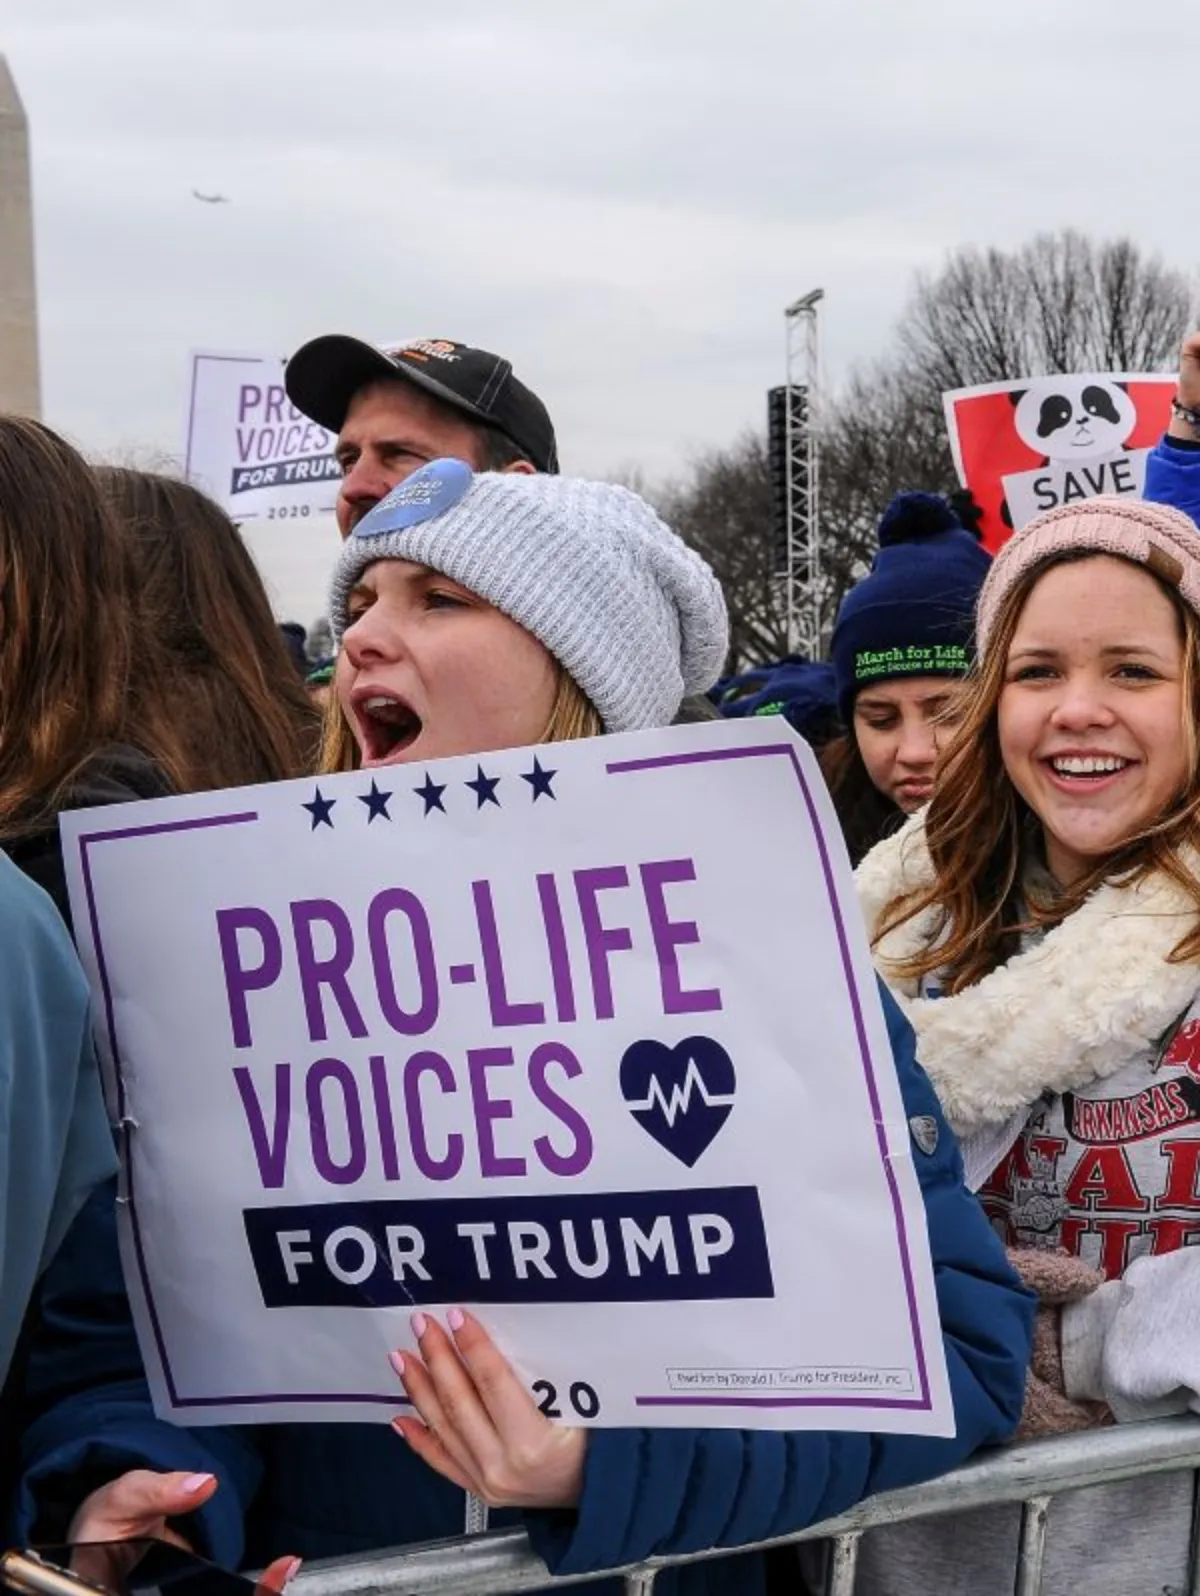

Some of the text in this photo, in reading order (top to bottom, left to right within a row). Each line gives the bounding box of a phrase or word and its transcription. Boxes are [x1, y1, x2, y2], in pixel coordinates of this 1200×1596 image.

[236, 424, 330, 462] VOICES
[237, 458, 341, 489] FOR TRUM
[1033, 458, 1136, 511] SAVE
[267, 505, 310, 520] 2020
[856, 645, 965, 667] March for Life
[216, 858, 722, 1048] PRO-LIFE
[233, 1041, 594, 1188] VOICES
[1072, 1081, 1190, 1140] ARKANSAS
[275, 1213, 734, 1285] FOR TRUMP
[731, 1373, 767, 1385] Donald
[815, 1371, 830, 1383] for
[532, 1379, 601, 1419] 20
